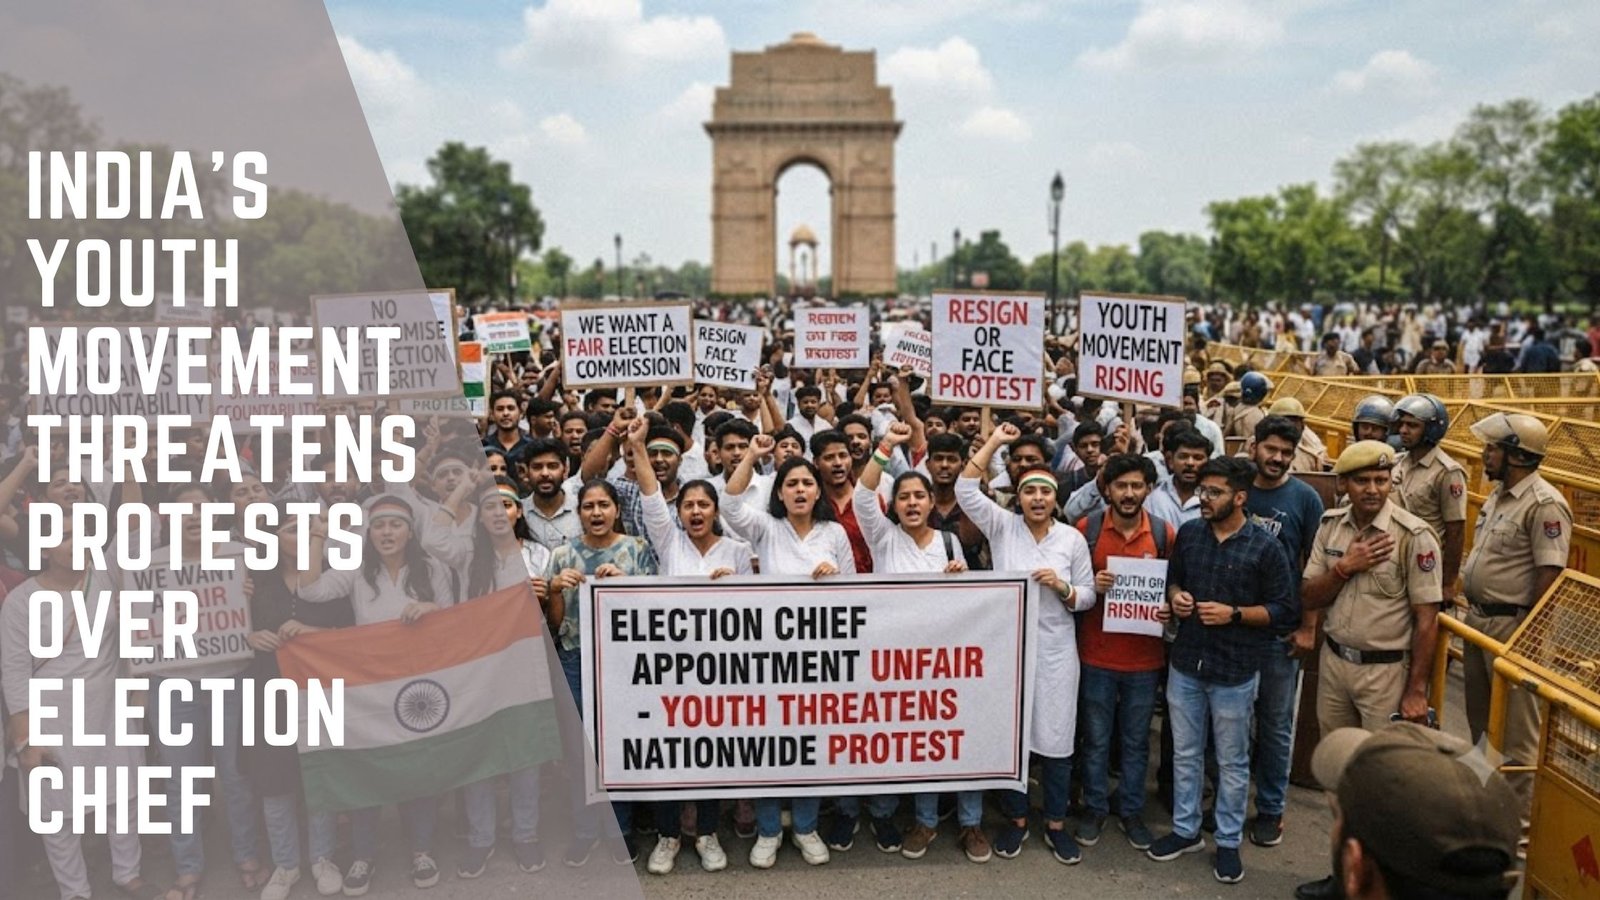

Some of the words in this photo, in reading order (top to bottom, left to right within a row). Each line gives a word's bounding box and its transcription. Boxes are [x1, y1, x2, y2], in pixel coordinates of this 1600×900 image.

[371, 300, 397, 320] NO
[949, 299, 1029, 326] RESIGN
[1098, 302, 1167, 333] YOUTH
[579, 315, 605, 334] WE
[609, 314, 658, 332] WANT
[662, 313, 674, 331] A
[699, 326, 747, 345] RESIGN
[567, 338, 604, 357] FAIR
[609, 335, 687, 355] ELECTION
[974, 327, 1001, 347] OR
[1082, 333, 1183, 365] MOVEMENT
[576, 357, 680, 379] COMMISSION
[962, 349, 1014, 374] FACE
[939, 373, 1036, 402] PROTEST
[1095, 364, 1164, 398] RISING
[42, 392, 204, 418] ACCOUNTABILITY
[133, 568, 167, 590] WE
[611, 607, 763, 642] ELECTION
[775, 606, 867, 640] CHIEF
[632, 650, 860, 685] APPOINTMENT
[871, 646, 984, 682] UNFAIR
[662, 695, 766, 727] YOUTH
[778, 688, 958, 726] THREATENS
[623, 735, 816, 770] NATIONWIDE
[828, 730, 965, 765] PROTEST
